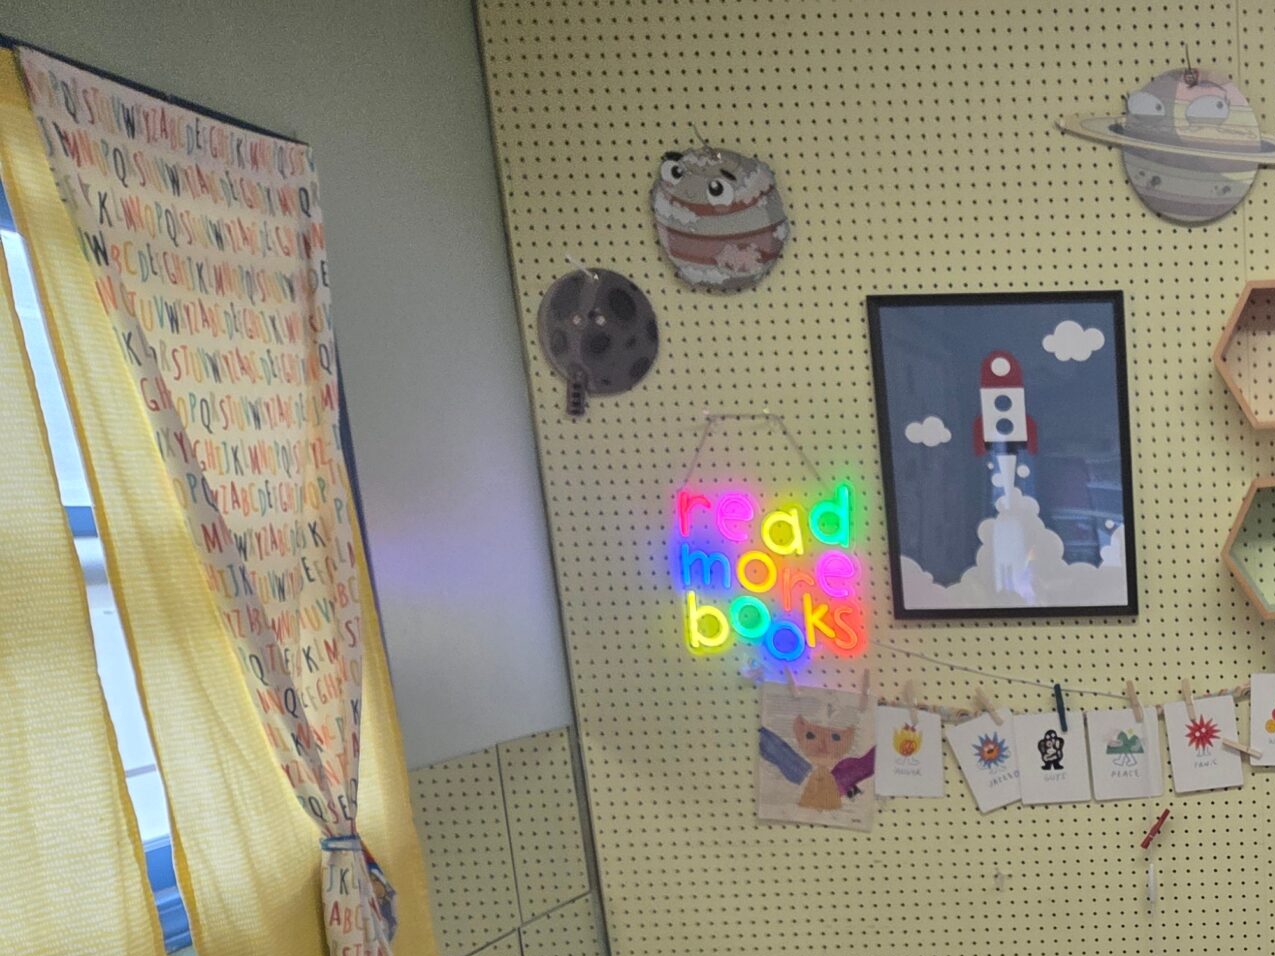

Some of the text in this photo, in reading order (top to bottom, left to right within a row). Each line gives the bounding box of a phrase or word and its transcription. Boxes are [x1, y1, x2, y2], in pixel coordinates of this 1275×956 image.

[677, 483, 851, 556] read
[680, 542, 856, 612] more
[686, 591, 859, 661] books
